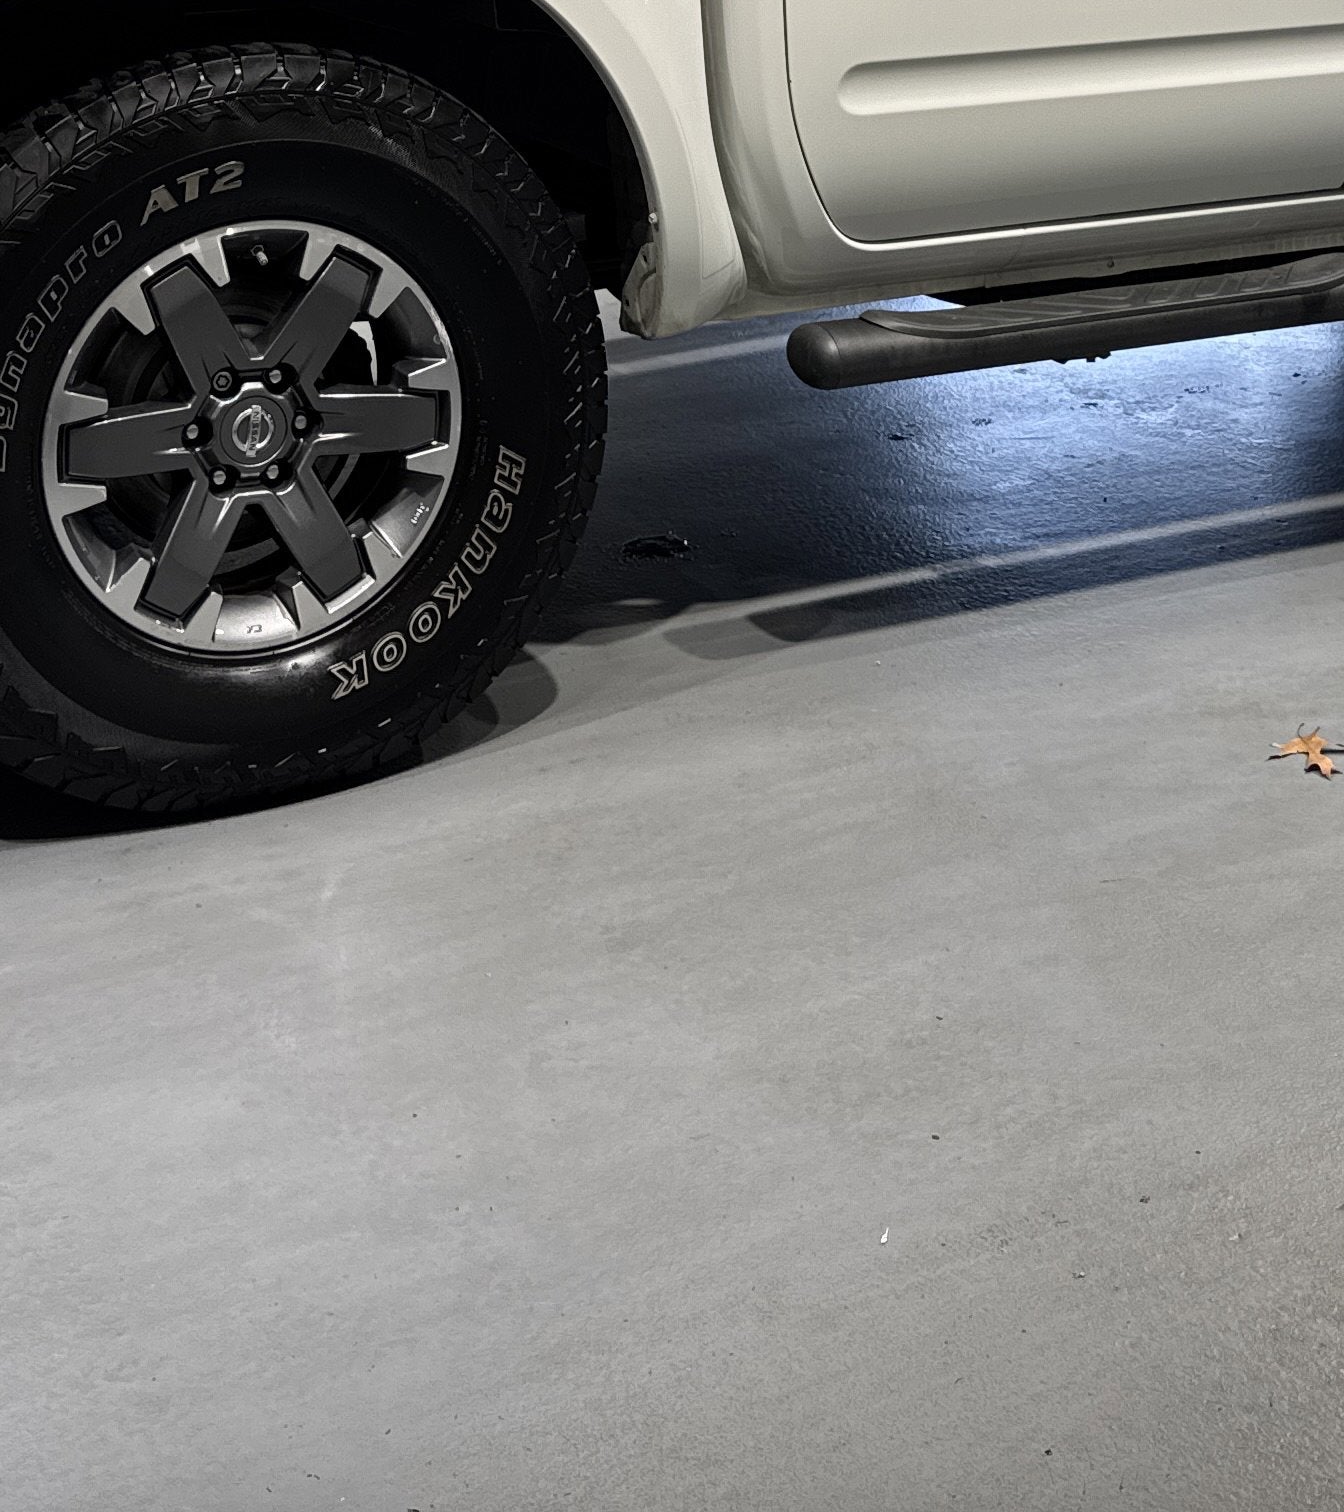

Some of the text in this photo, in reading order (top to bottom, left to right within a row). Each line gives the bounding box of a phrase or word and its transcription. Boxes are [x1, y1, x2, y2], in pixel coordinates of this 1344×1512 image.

[140, 160, 245, 226] AT2
[248, 410, 262, 452] NISSAN
[327, 445, 527, 700] Hankook
